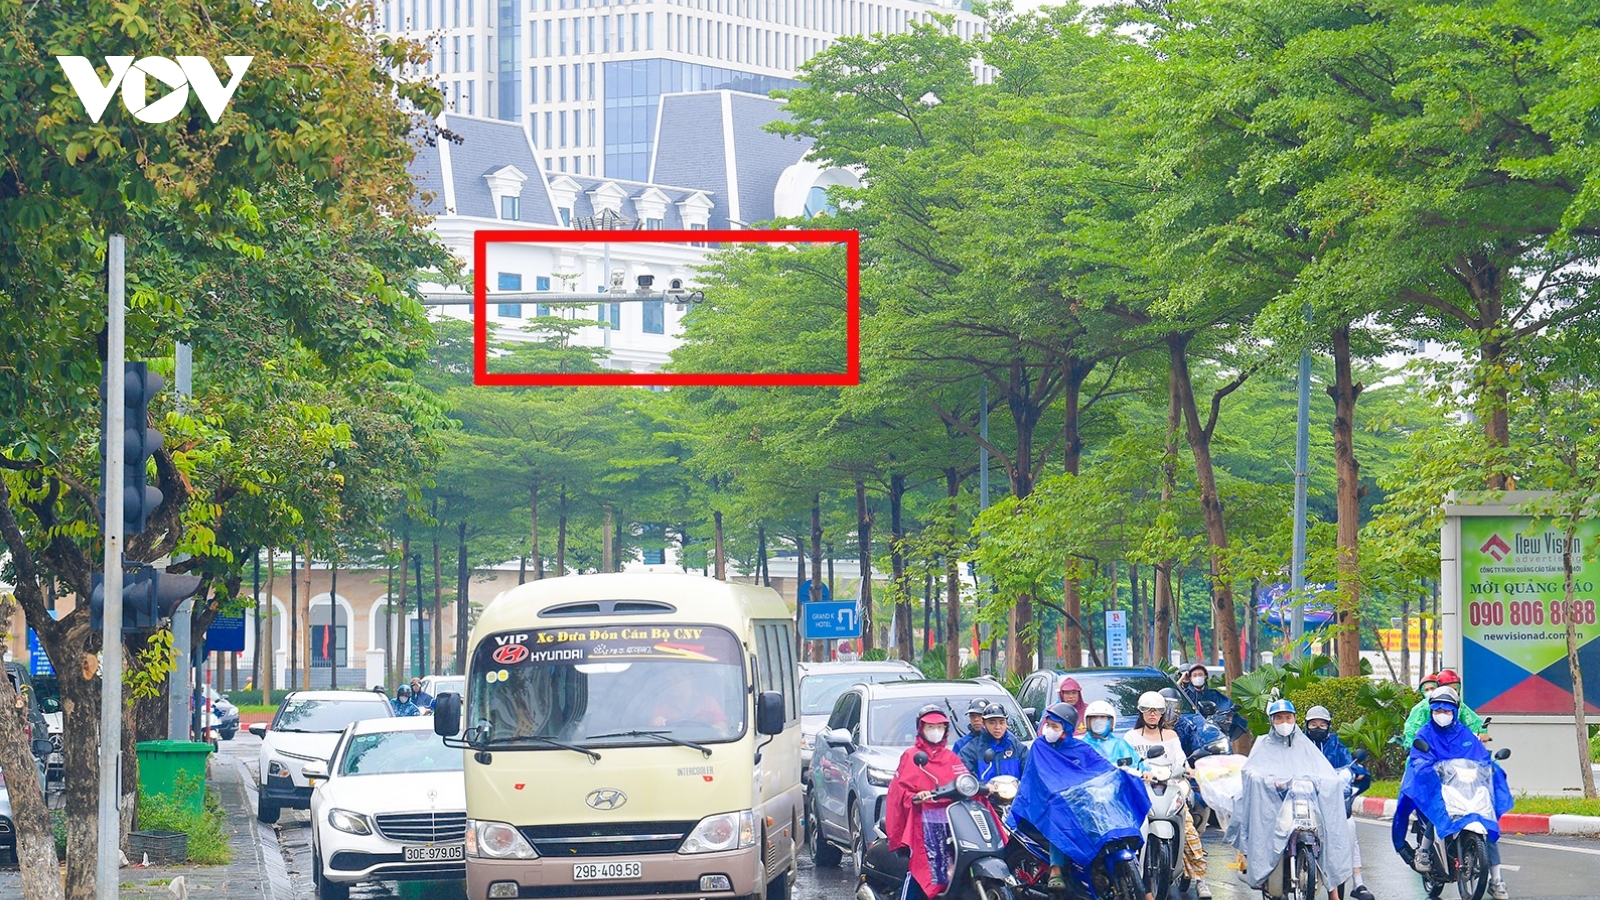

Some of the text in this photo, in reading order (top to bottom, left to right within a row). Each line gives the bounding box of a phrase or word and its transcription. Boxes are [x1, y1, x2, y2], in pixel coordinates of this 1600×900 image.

[1516, 532, 1580, 554] New Visin
[1516, 555, 1582, 564] advertisg
[1470, 581, 1500, 594] MỜI
[1504, 579, 1557, 595] QUẢNG
[1470, 601, 1504, 626] 090
[1510, 600, 1544, 626] 806
[494, 634, 528, 645] VIP
[558, 631, 586, 642] Đưa
[590, 629, 618, 640] Đón
[621, 628, 647, 639] Cán
[651, 628, 670, 642] Bộ
[673, 628, 702, 640] CNV
[531, 649, 583, 661] HYUNDAI
[677, 766, 714, 776] INTERCOOLER
[407, 847, 461, 859] 30E-979.05
[576, 863, 640, 878] 29B-409.58
